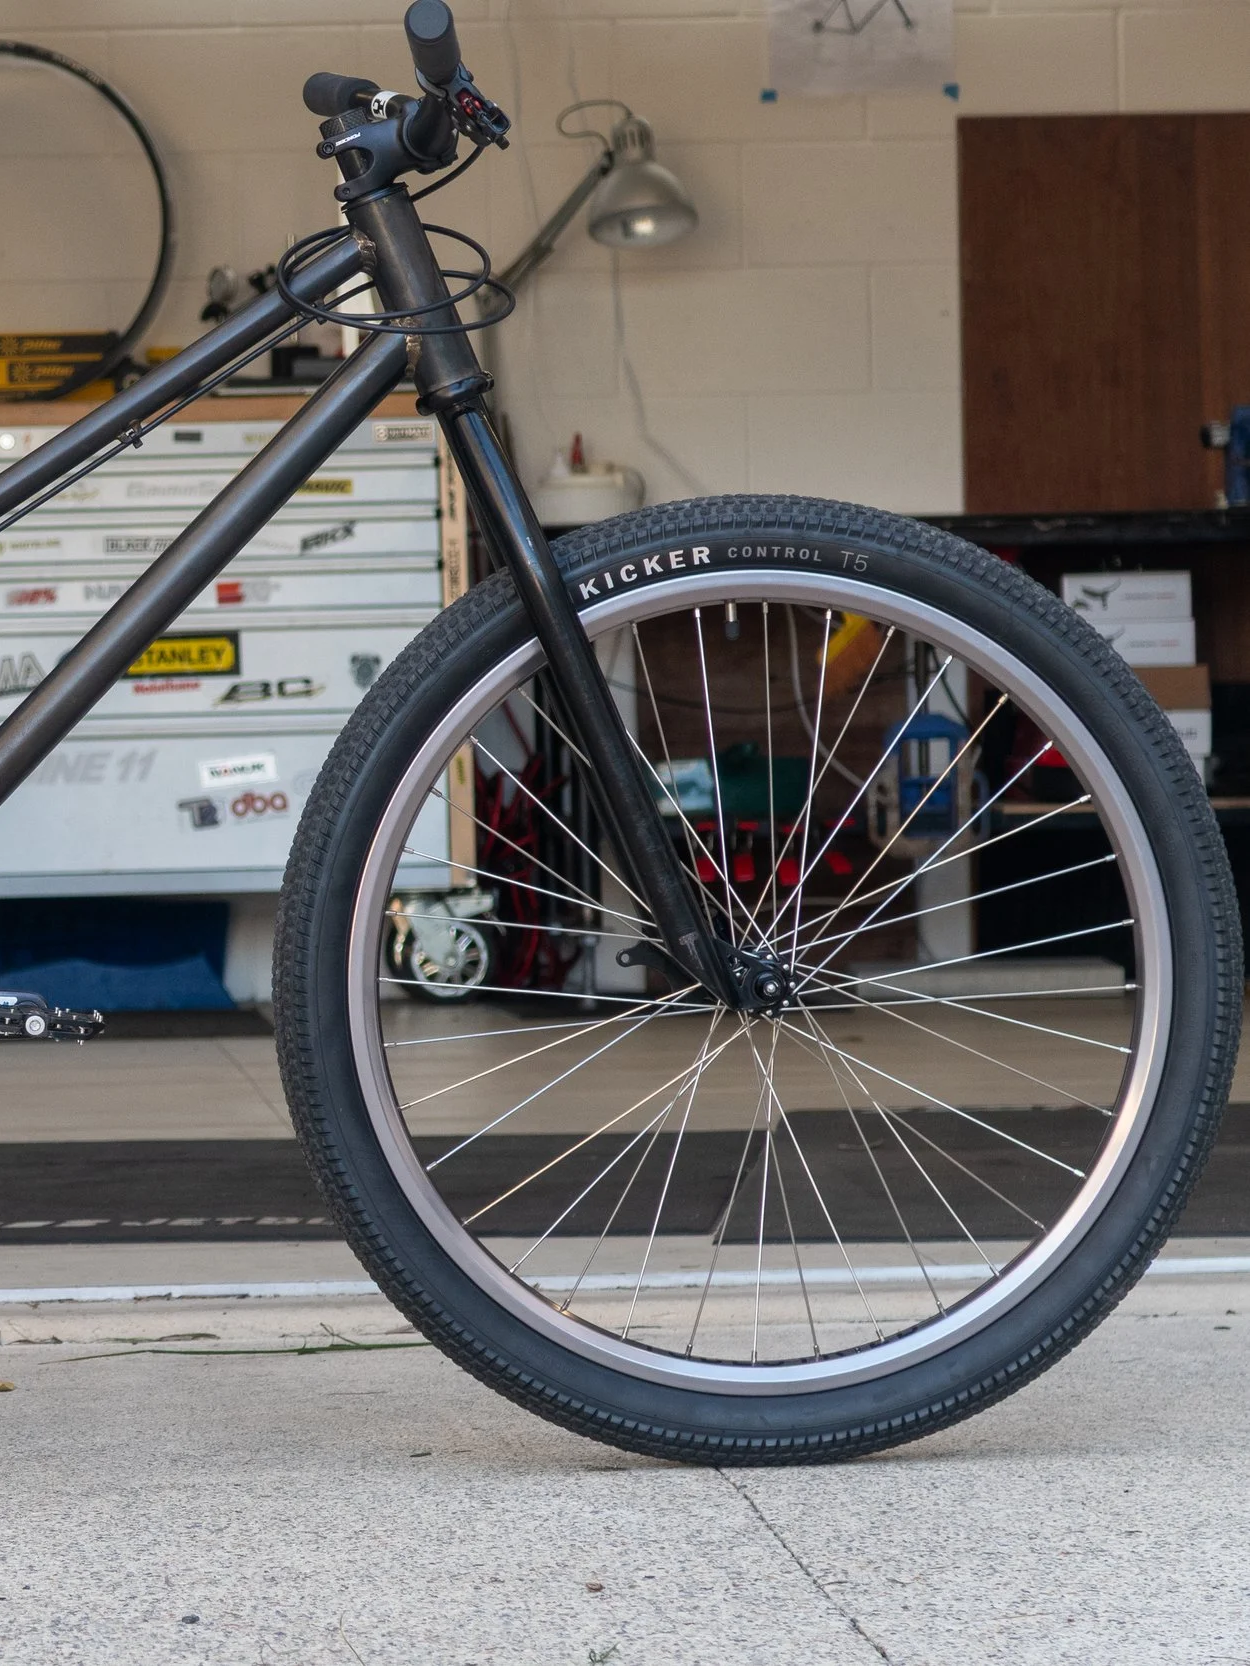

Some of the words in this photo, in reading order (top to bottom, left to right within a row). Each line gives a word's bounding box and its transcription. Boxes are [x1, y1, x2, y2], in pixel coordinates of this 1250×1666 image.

[578, 546, 711, 600] KICKER
[727, 546, 822, 562] CONTROL
[840, 550, 870, 573] T5
